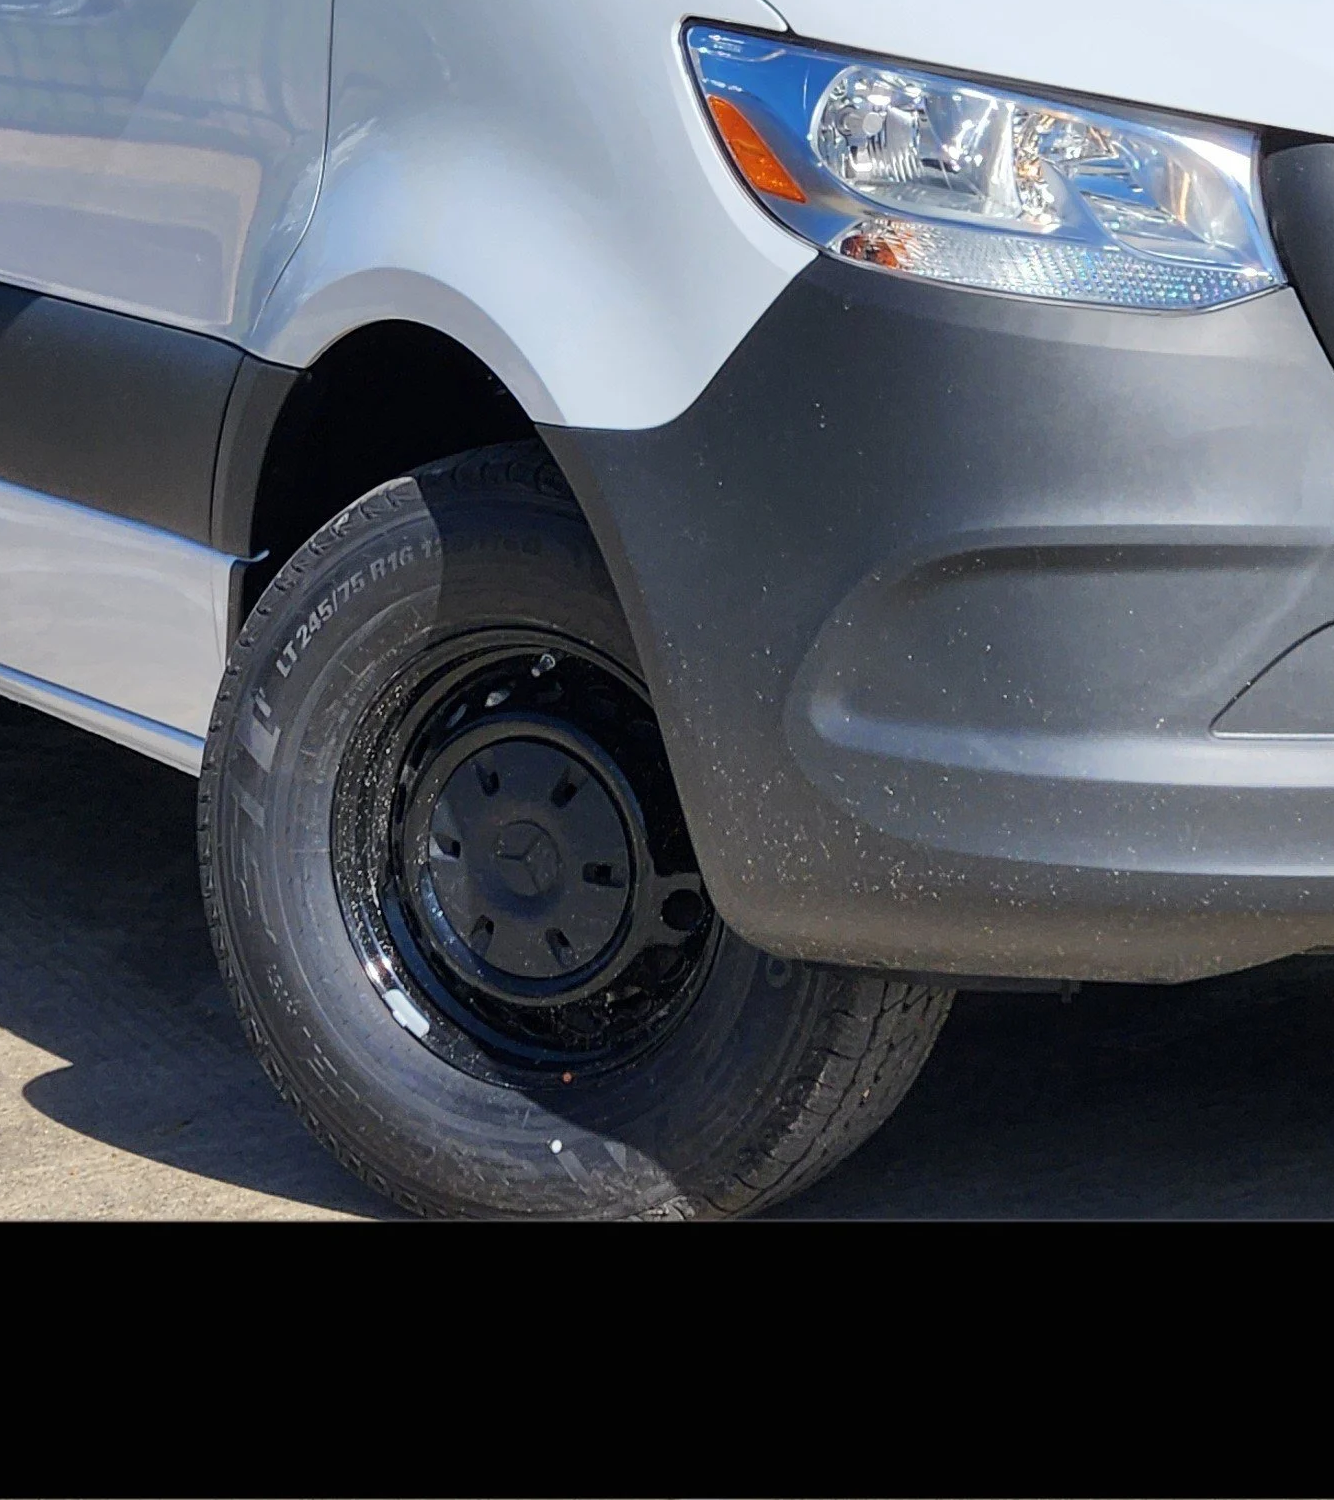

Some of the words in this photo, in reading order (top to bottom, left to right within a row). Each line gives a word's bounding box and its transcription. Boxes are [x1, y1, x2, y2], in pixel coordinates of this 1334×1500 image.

[275, 639, 299, 679] LT
[295, 569, 366, 650] 245/75
[369, 544, 414, 583] R16
